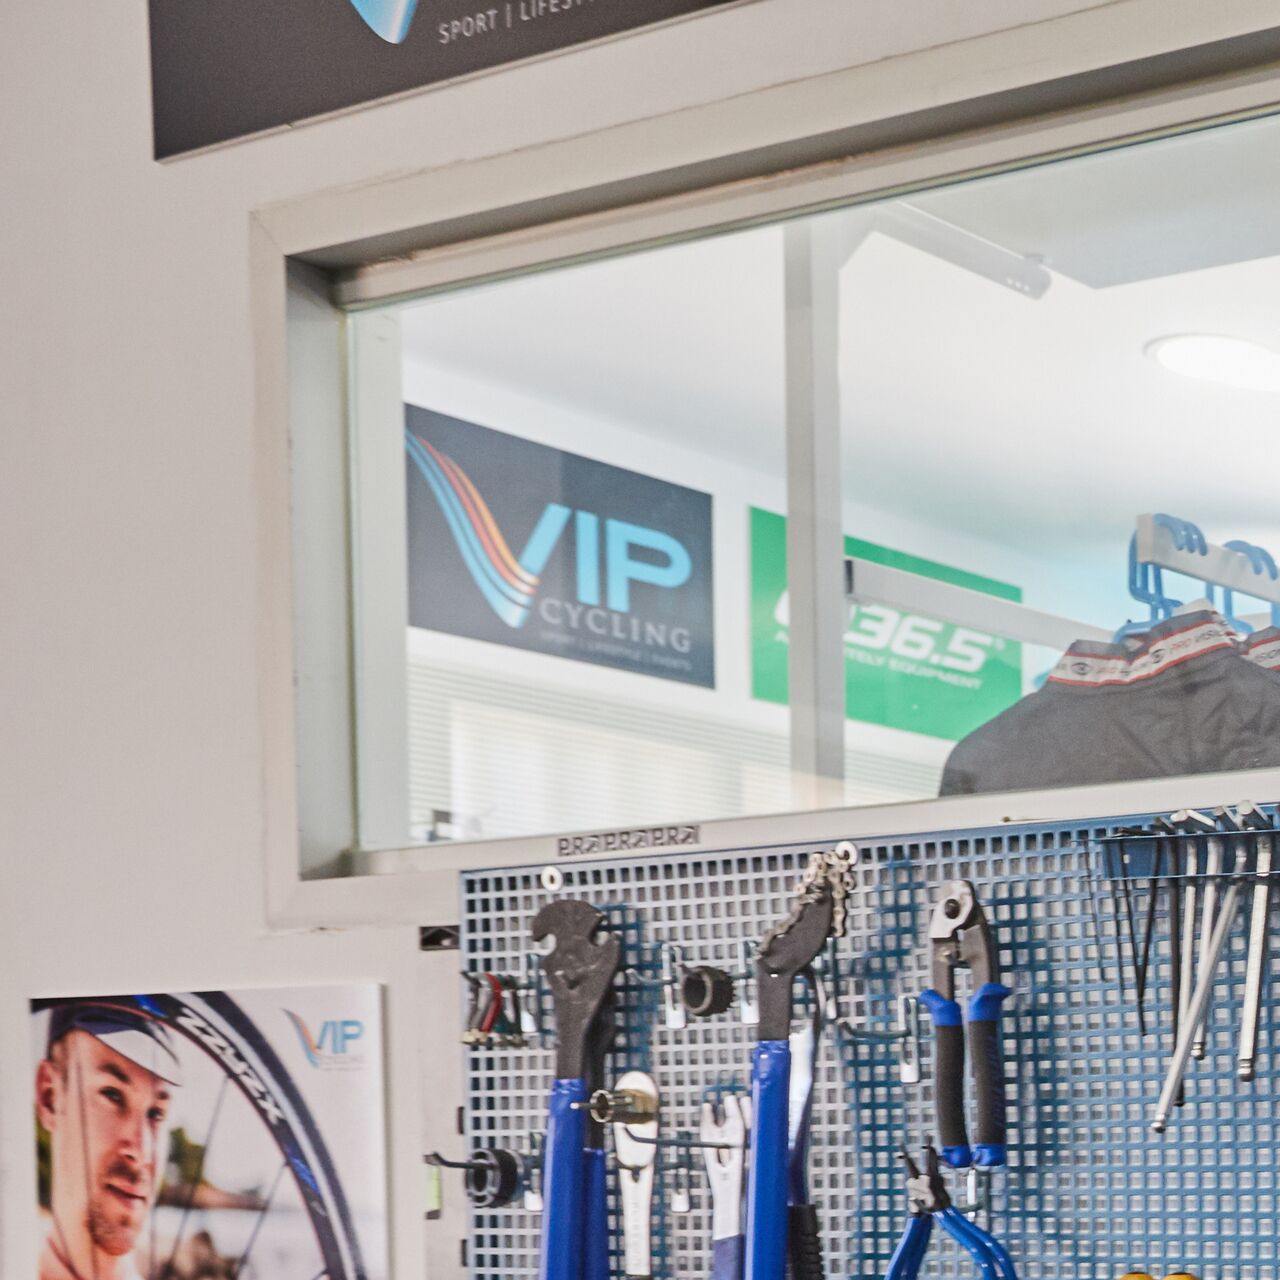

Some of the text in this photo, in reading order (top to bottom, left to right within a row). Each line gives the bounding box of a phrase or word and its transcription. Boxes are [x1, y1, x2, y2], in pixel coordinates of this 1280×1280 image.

[437, 9, 499, 44] SPORT
[416, 450, 692, 628] VIP
[538, 598, 692, 653] CYCLING
[286, 1013, 365, 1066] VIP
